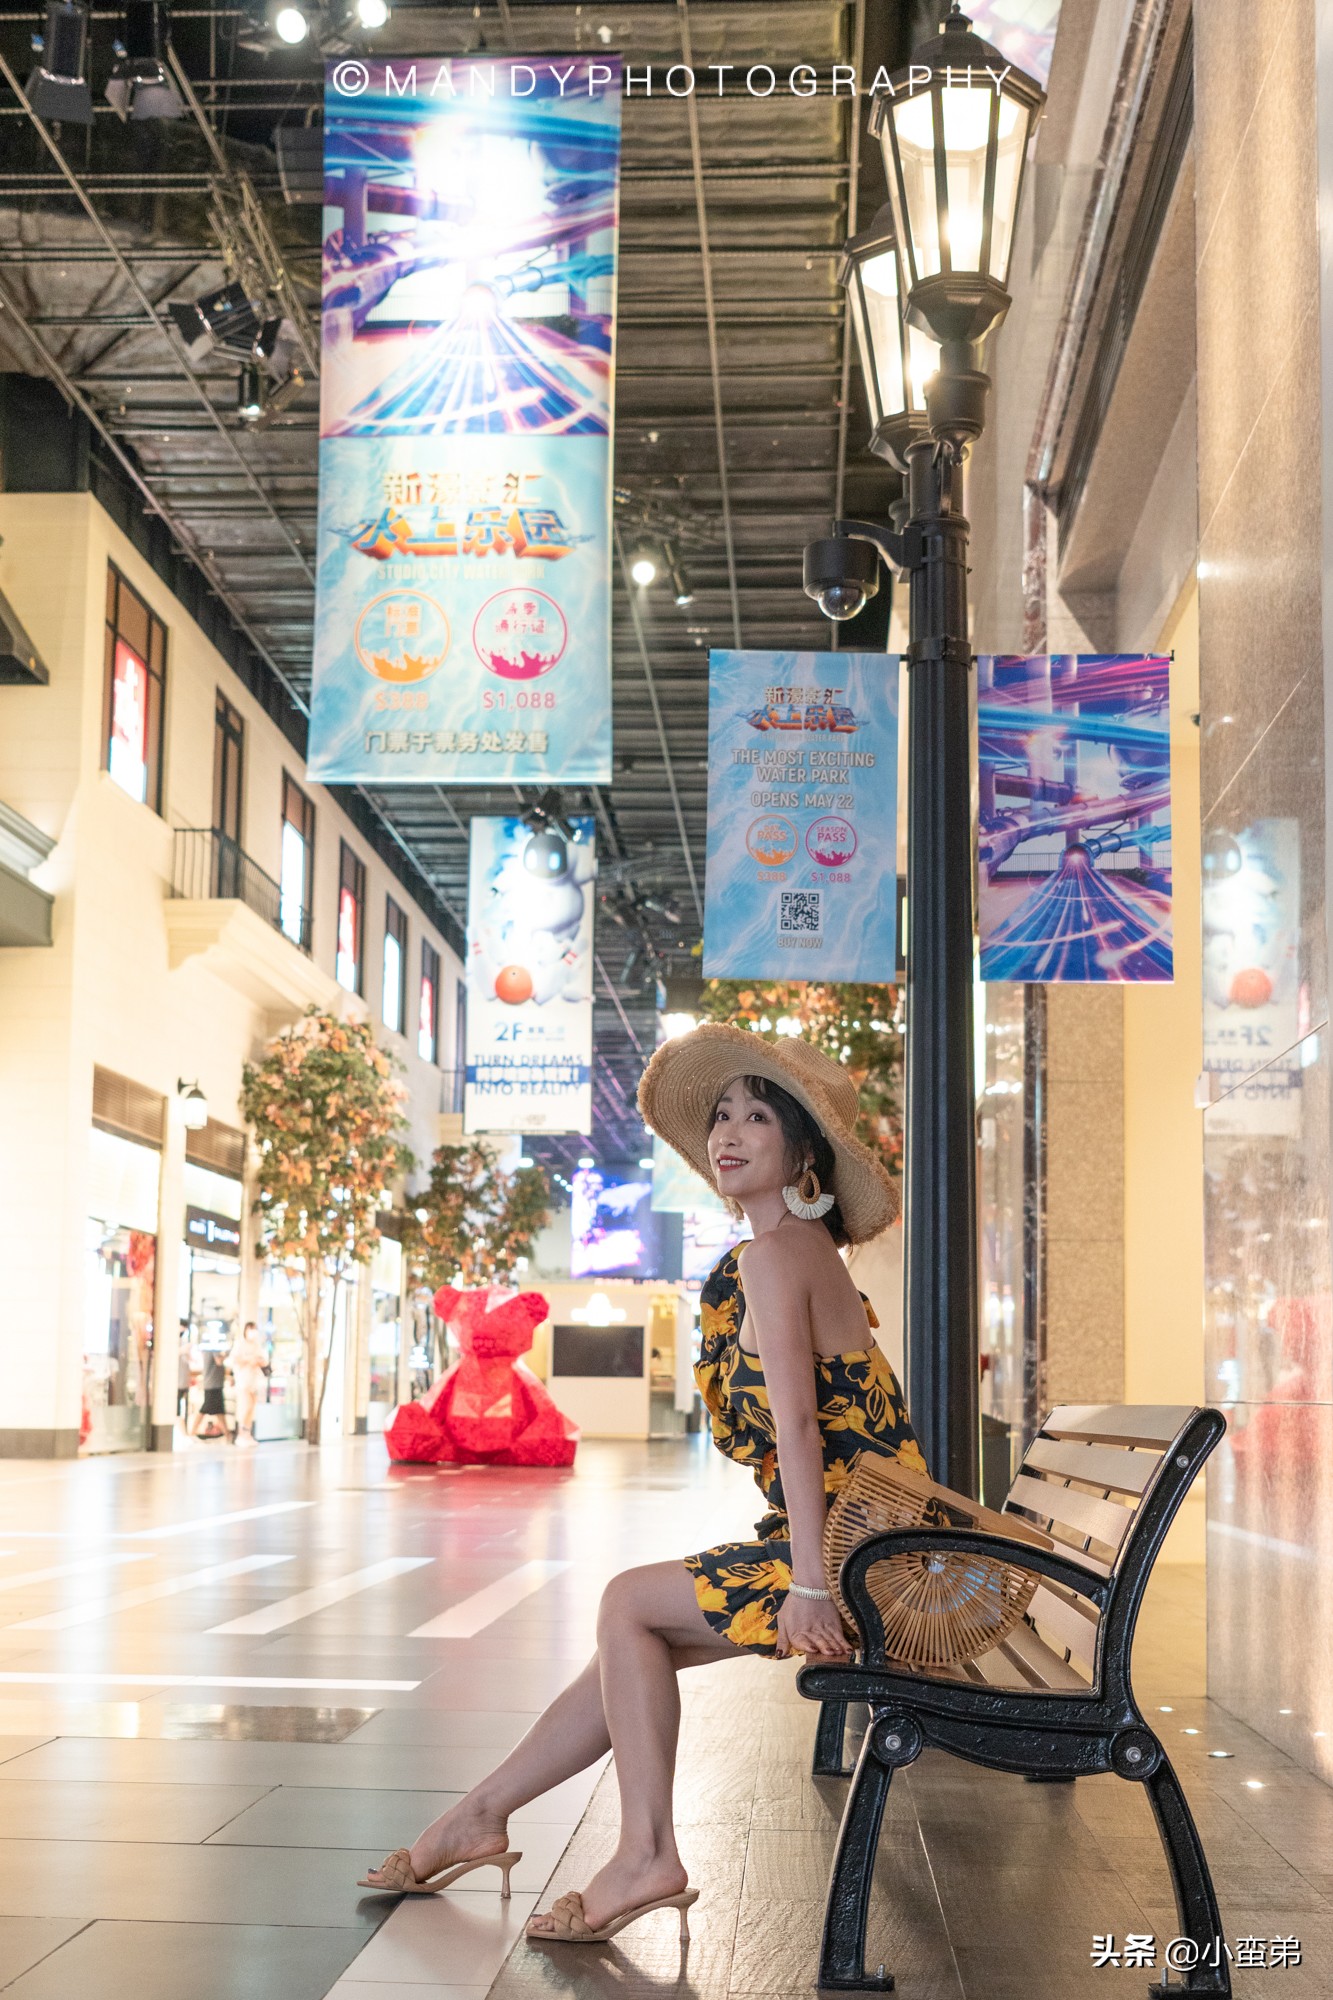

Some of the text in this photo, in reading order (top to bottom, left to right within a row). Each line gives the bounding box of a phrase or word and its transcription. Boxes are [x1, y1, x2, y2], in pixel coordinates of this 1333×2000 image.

[346, 506, 578, 560] 水上乐园
[483, 691, 556, 710] $1,088
[365, 731, 549, 754] 门票于票务处发售
[732, 749, 875, 767] THE MOST EXCITING
[757, 767, 849, 784] WATER PARK
[751, 791, 854, 809] OPENS MAY 22
[757, 831, 787, 841] PASS
[817, 833, 846, 842] PASS
[811, 872, 851, 883] $1,088
[777, 937, 823, 948] BUY NOW
[495, 1022, 523, 1041] 2F
